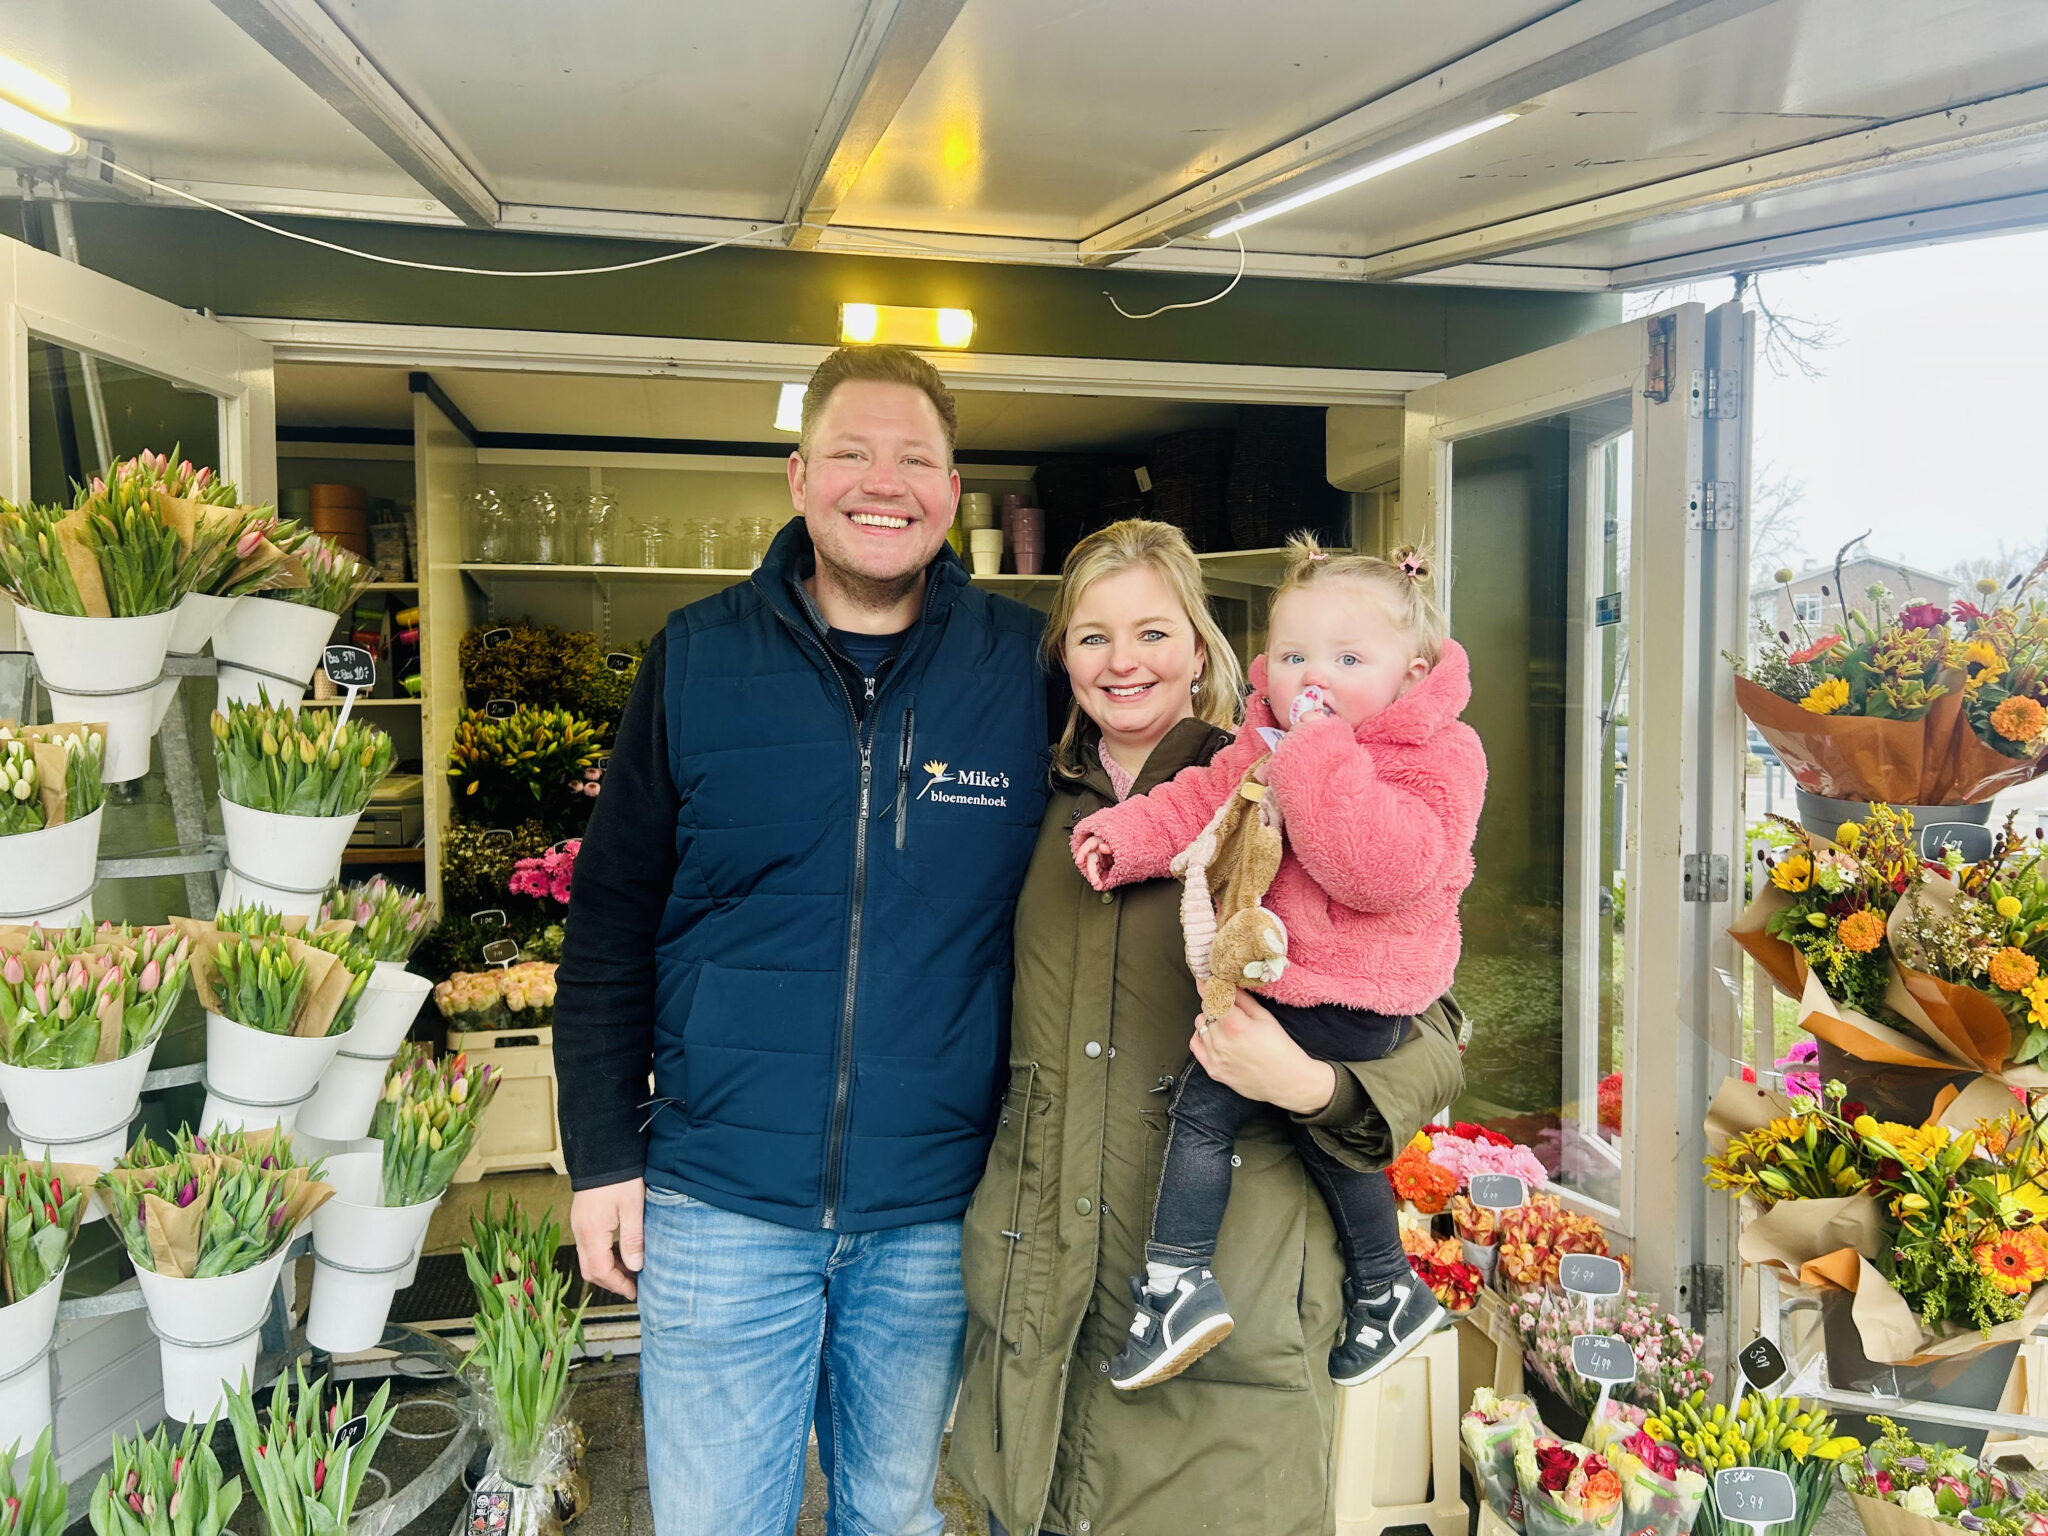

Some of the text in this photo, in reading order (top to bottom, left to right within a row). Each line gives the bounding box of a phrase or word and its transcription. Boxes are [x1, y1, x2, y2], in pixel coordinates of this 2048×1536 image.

[333, 670, 341, 679] 2
[957, 770, 1010, 788] Mike's
[930, 790, 1008, 808] bloemenhoek
[1581, 1338, 1589, 1346] 10
[1723, 1472, 1731, 1484] 5
